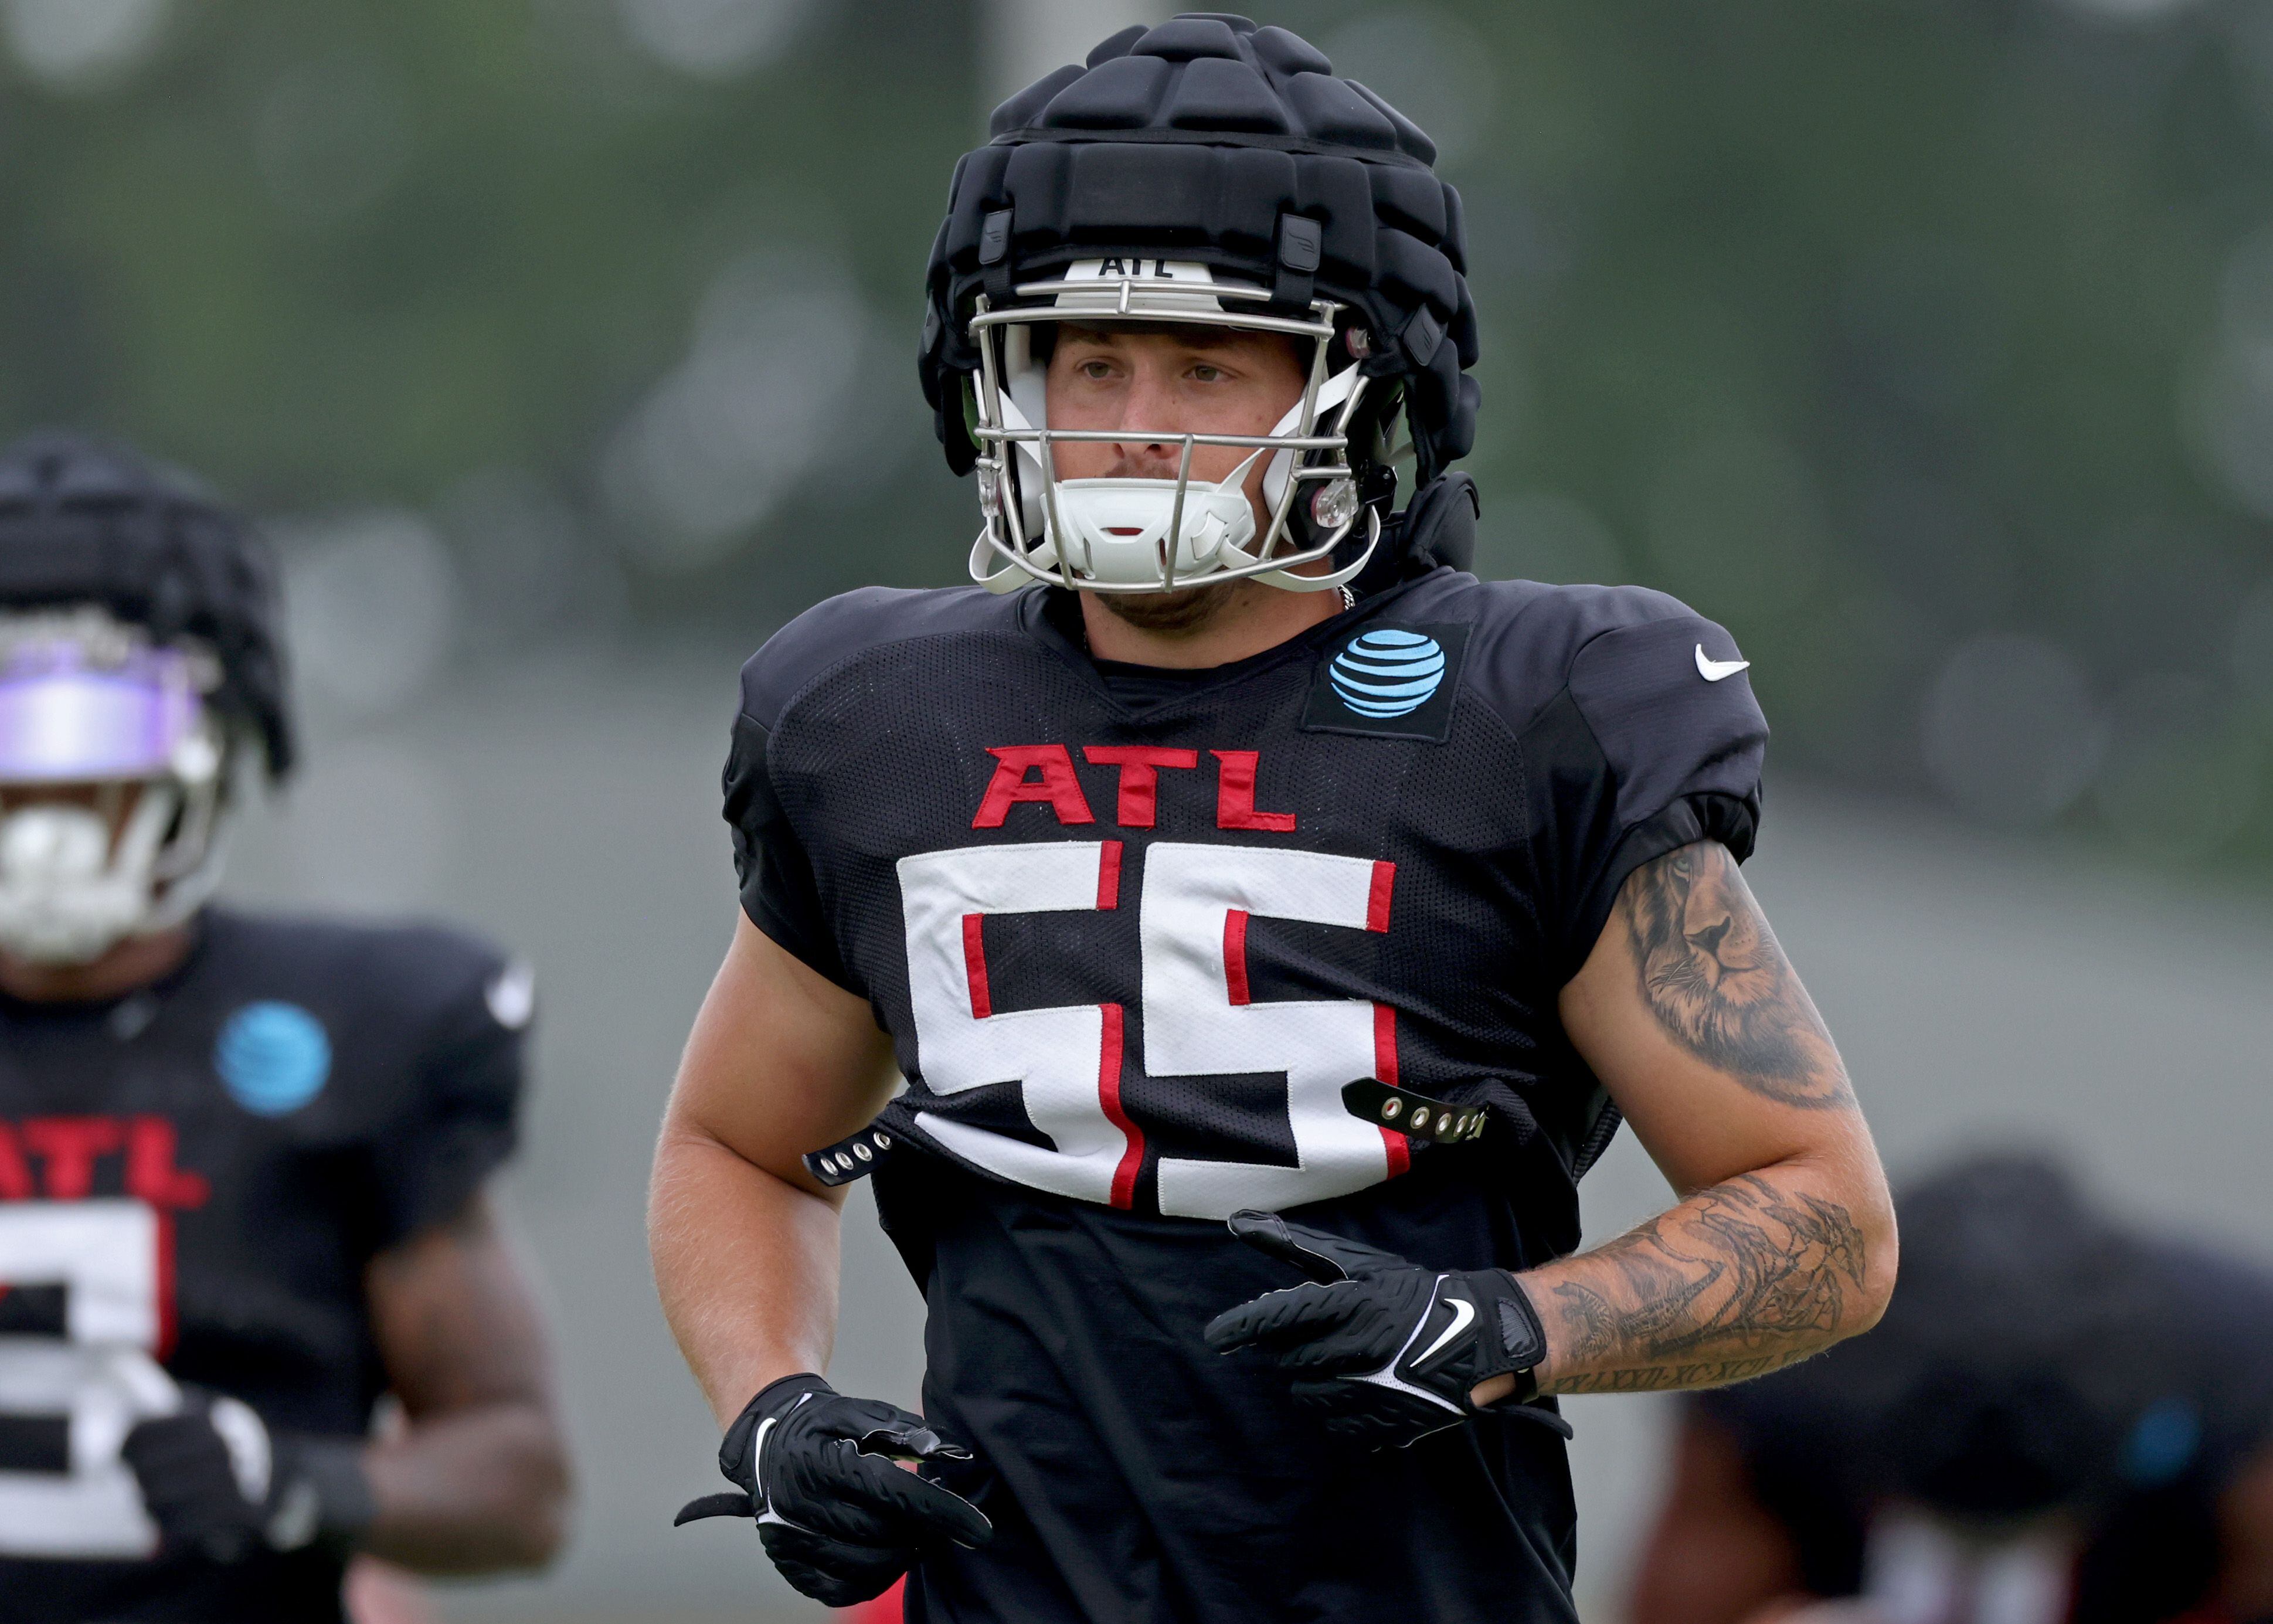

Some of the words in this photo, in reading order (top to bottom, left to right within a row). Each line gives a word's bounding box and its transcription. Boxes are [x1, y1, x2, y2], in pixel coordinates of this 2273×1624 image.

[971, 744, 1296, 831] ATL
[896, 840, 1409, 1221] 55
[0, 1114, 209, 1209] TL
